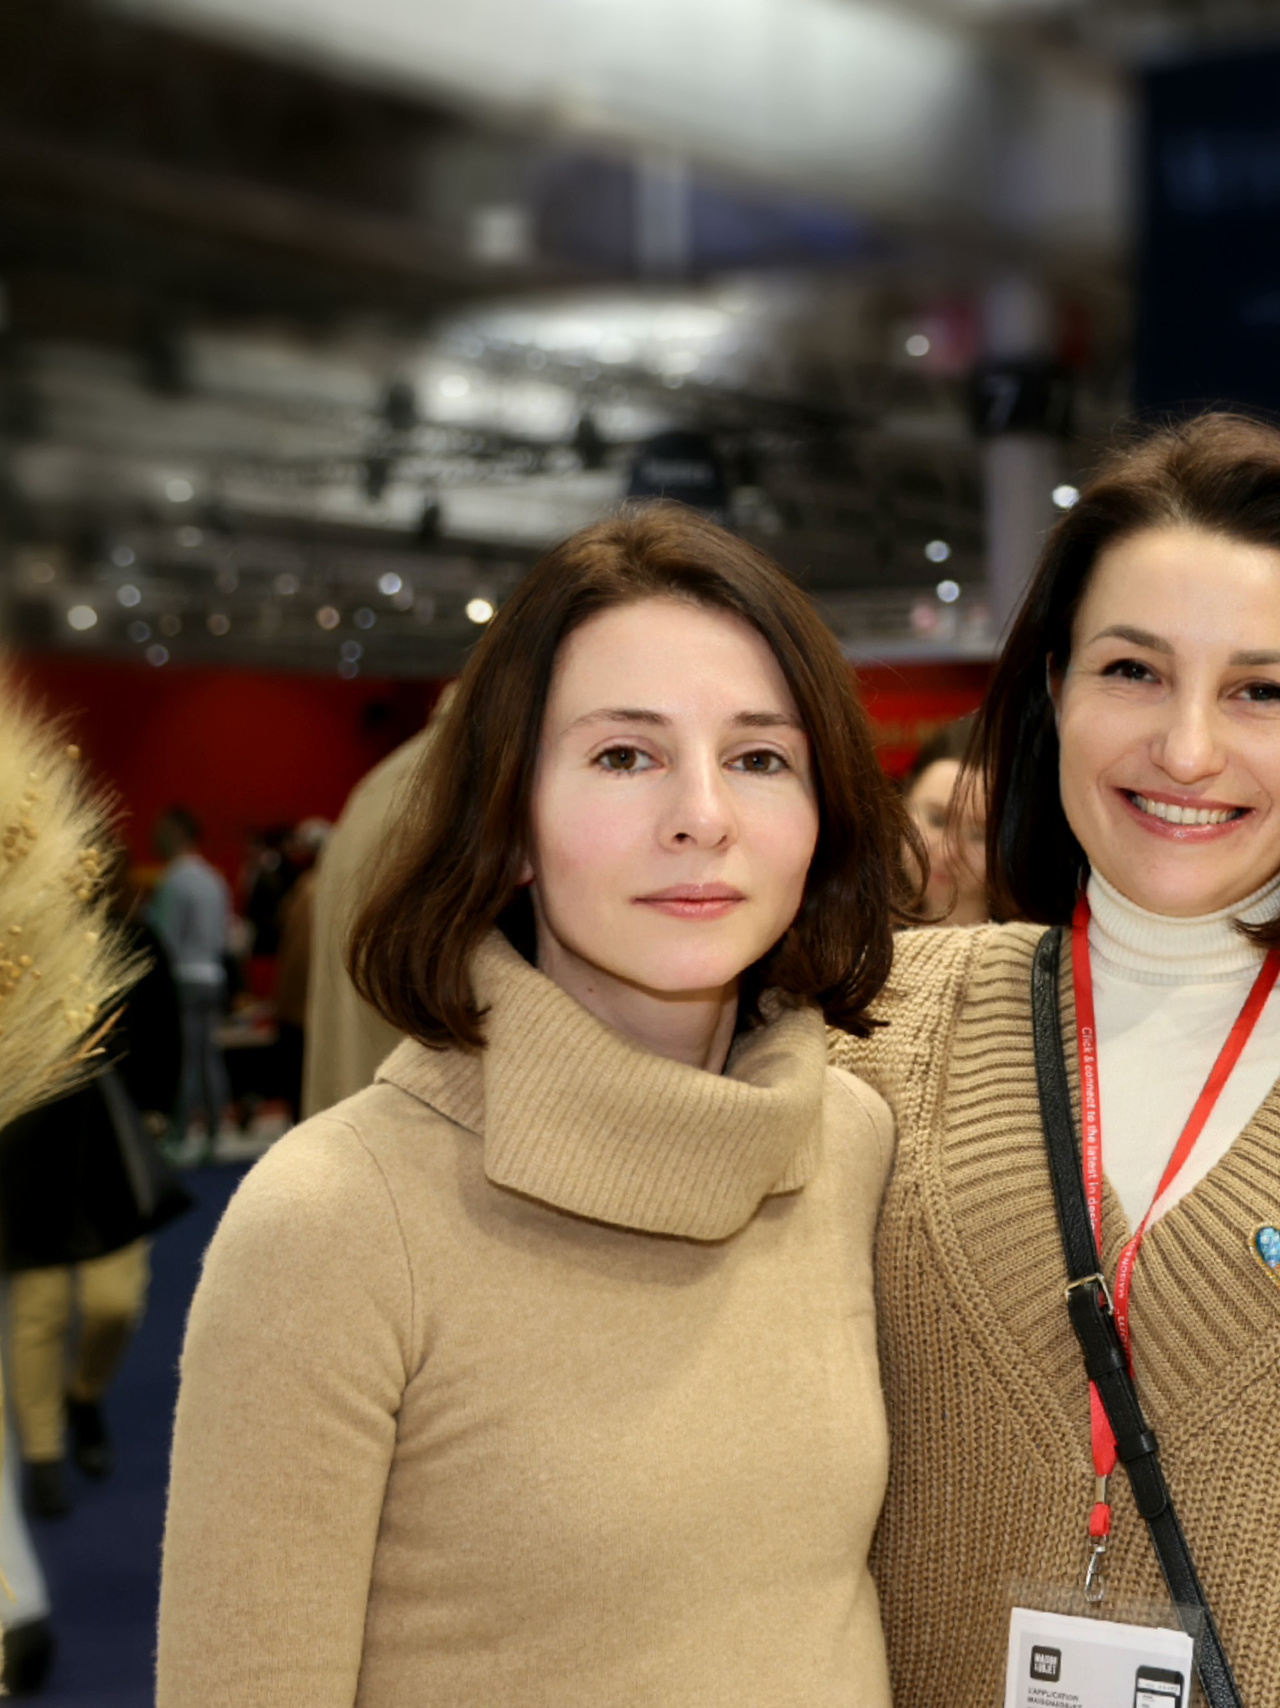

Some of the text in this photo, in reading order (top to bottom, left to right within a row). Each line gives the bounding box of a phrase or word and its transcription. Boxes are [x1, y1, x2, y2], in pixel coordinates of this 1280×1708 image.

[1081, 1027, 1094, 1054] Click
[1084, 1055, 1094, 1063] &
[1084, 1064, 1096, 1109] connect
[1086, 1109, 1097, 1121] to
[1087, 1125, 1099, 1143] the
[1086, 1145, 1099, 1179] latest
[1088, 1182, 1100, 1194] in
